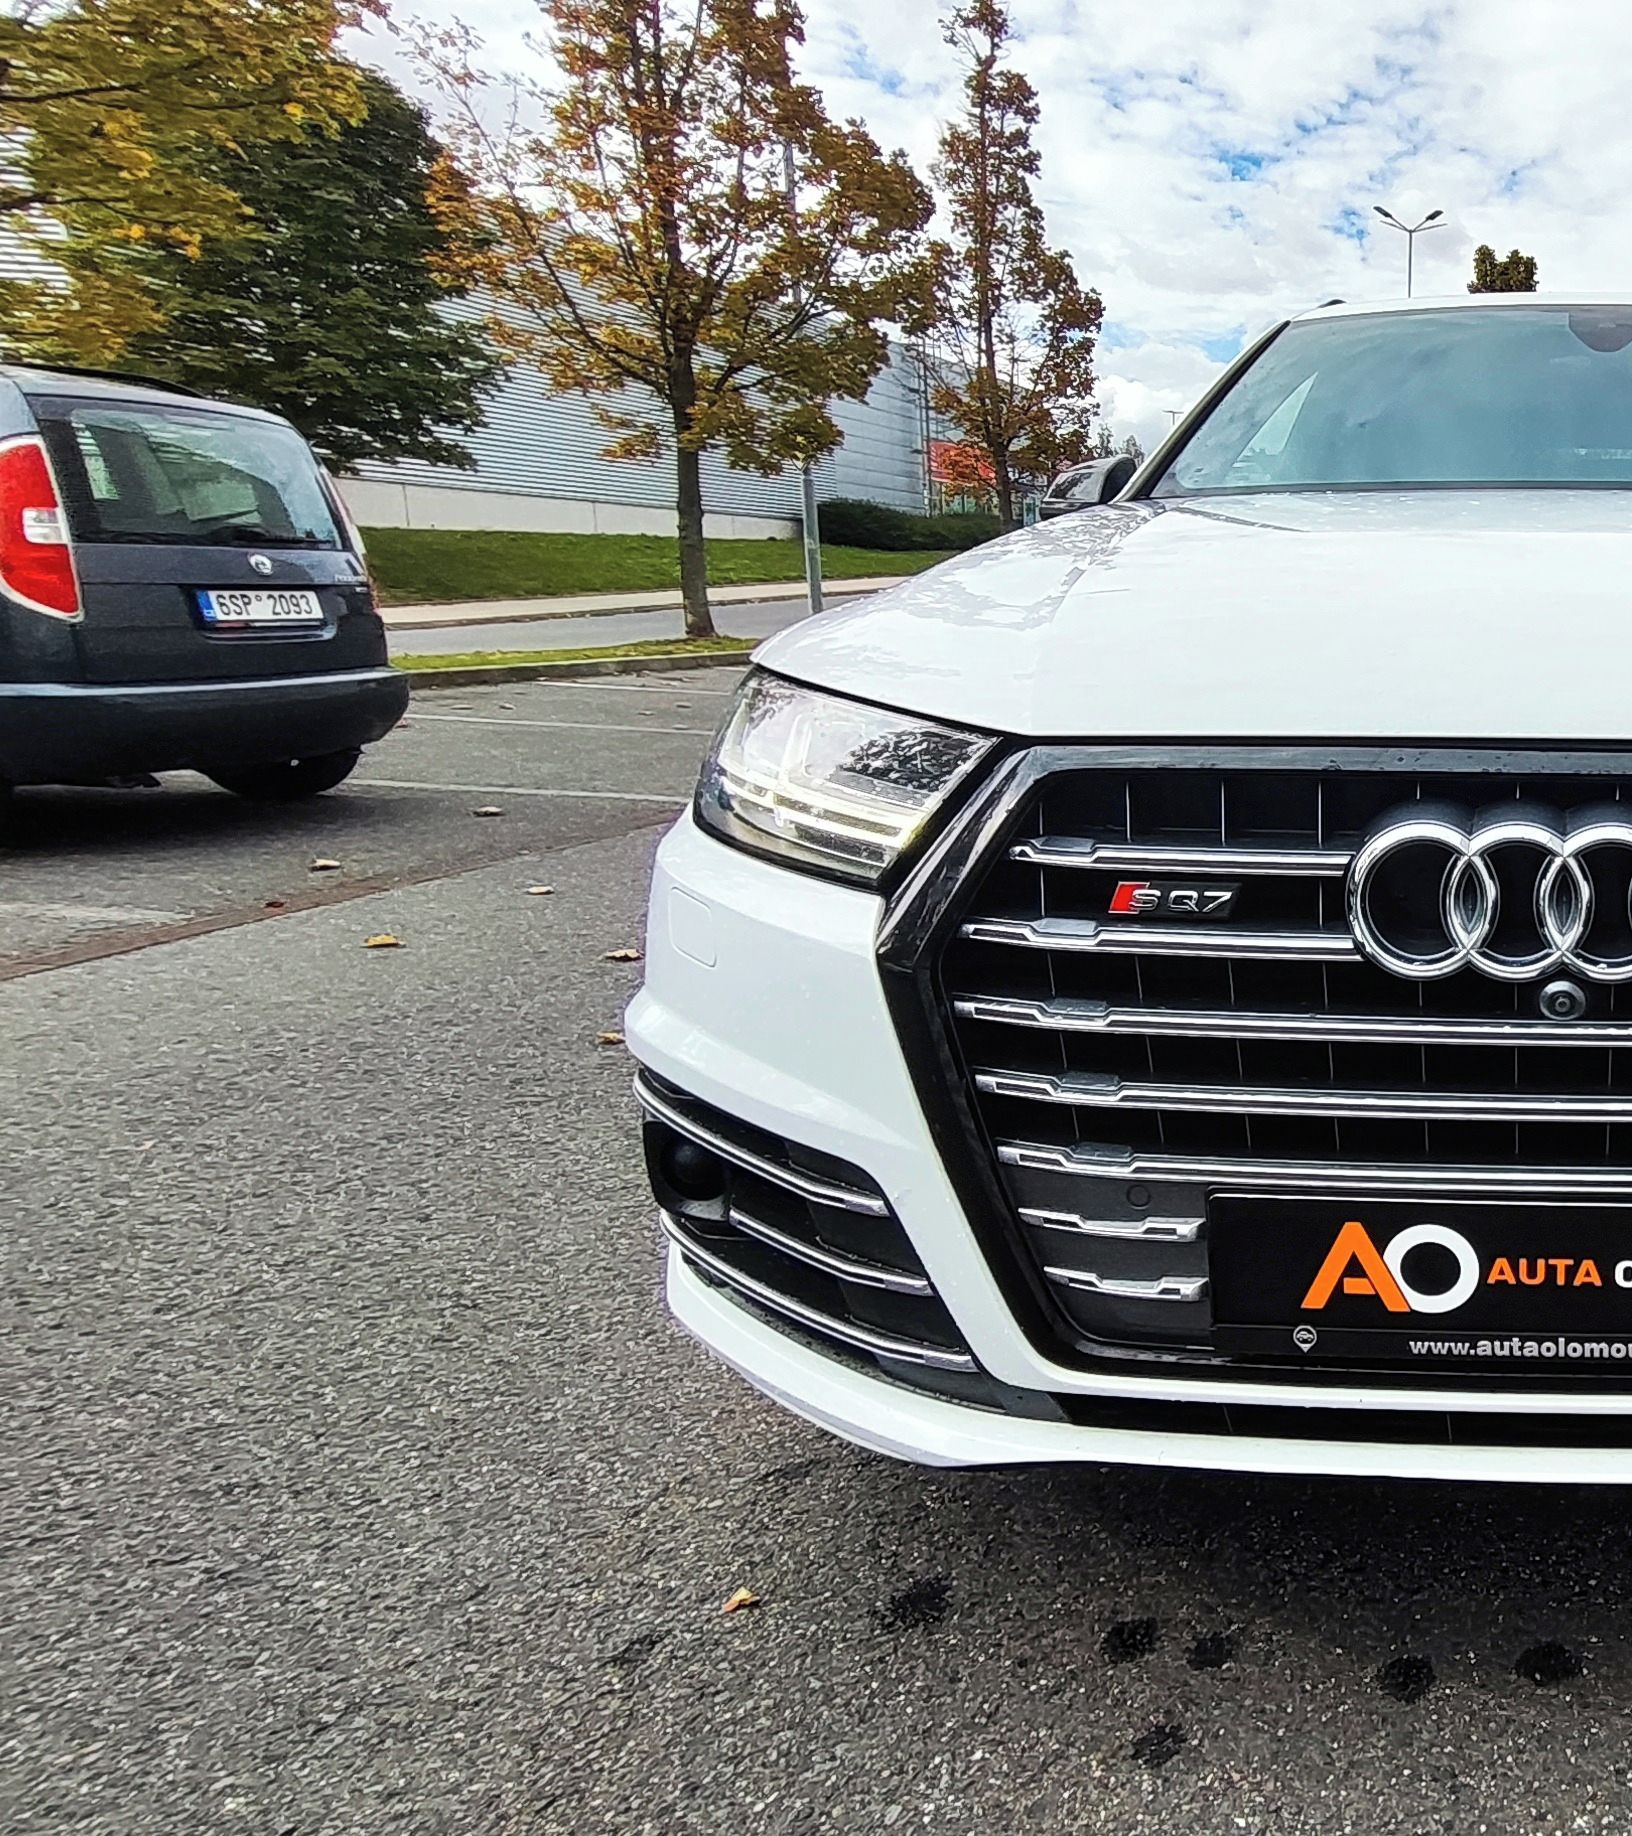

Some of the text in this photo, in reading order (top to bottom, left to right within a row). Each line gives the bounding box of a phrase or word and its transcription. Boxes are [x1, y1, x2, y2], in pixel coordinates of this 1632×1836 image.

[216, 594, 313, 616] 6SP 2093
[1128, 888, 1233, 913] SQ7
[1301, 1221, 1480, 1314] AO
[1487, 1259, 1603, 1287] AUTA
